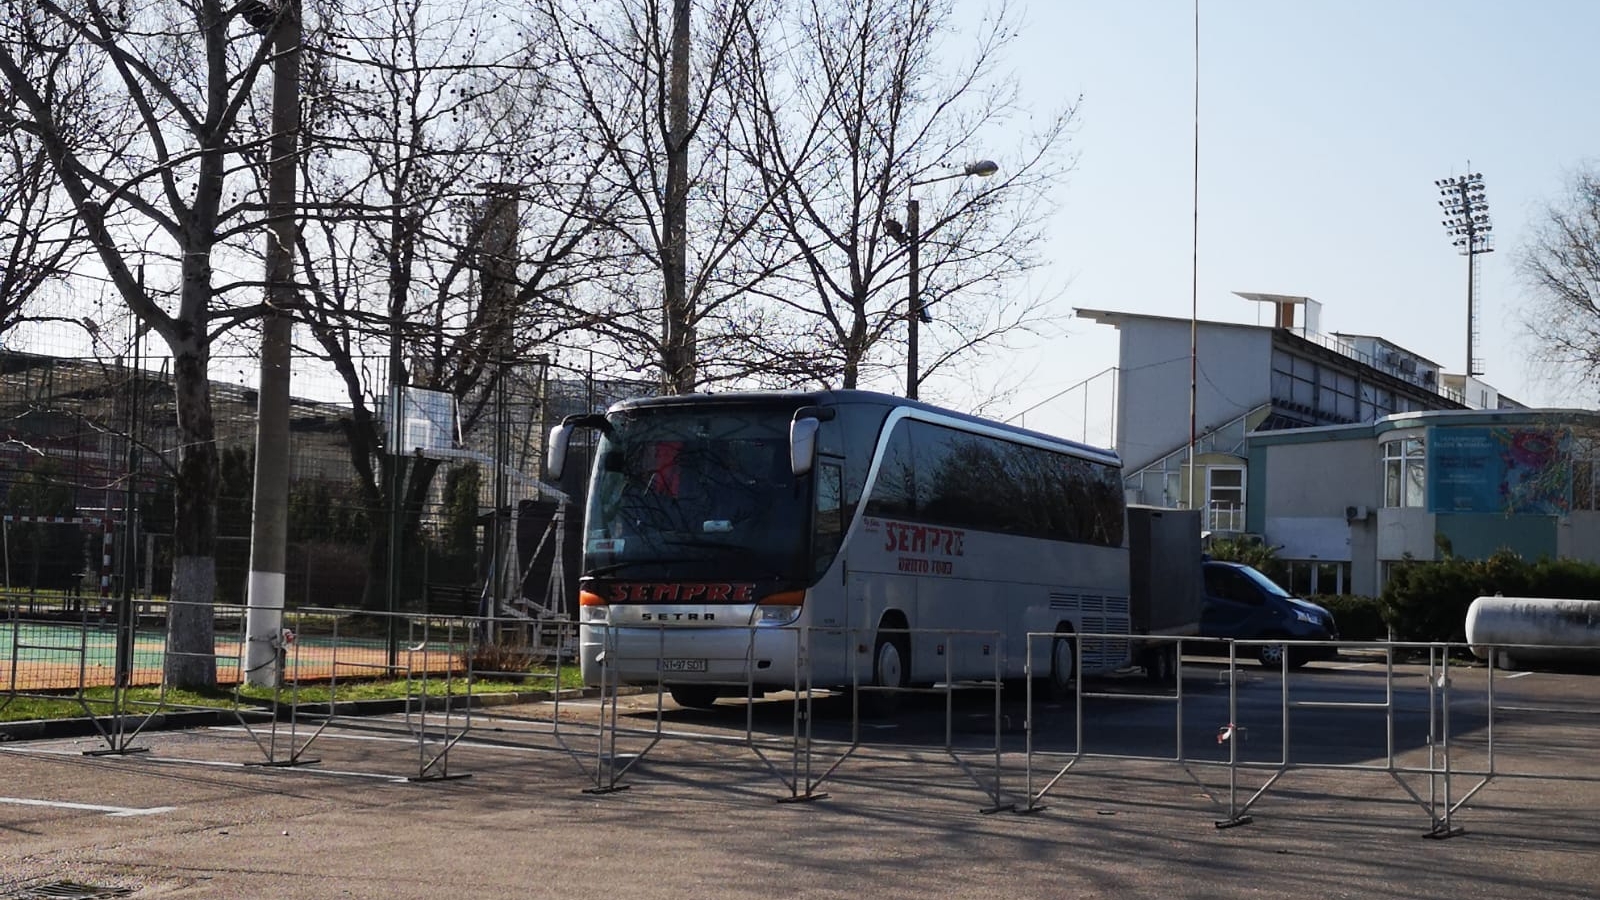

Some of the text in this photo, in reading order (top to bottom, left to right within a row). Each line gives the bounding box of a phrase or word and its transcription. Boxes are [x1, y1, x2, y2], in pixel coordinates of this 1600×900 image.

[885, 521, 965, 556] SEMPRE
[611, 583, 755, 601] SEMPRE
[642, 613, 715, 621] SETRA
